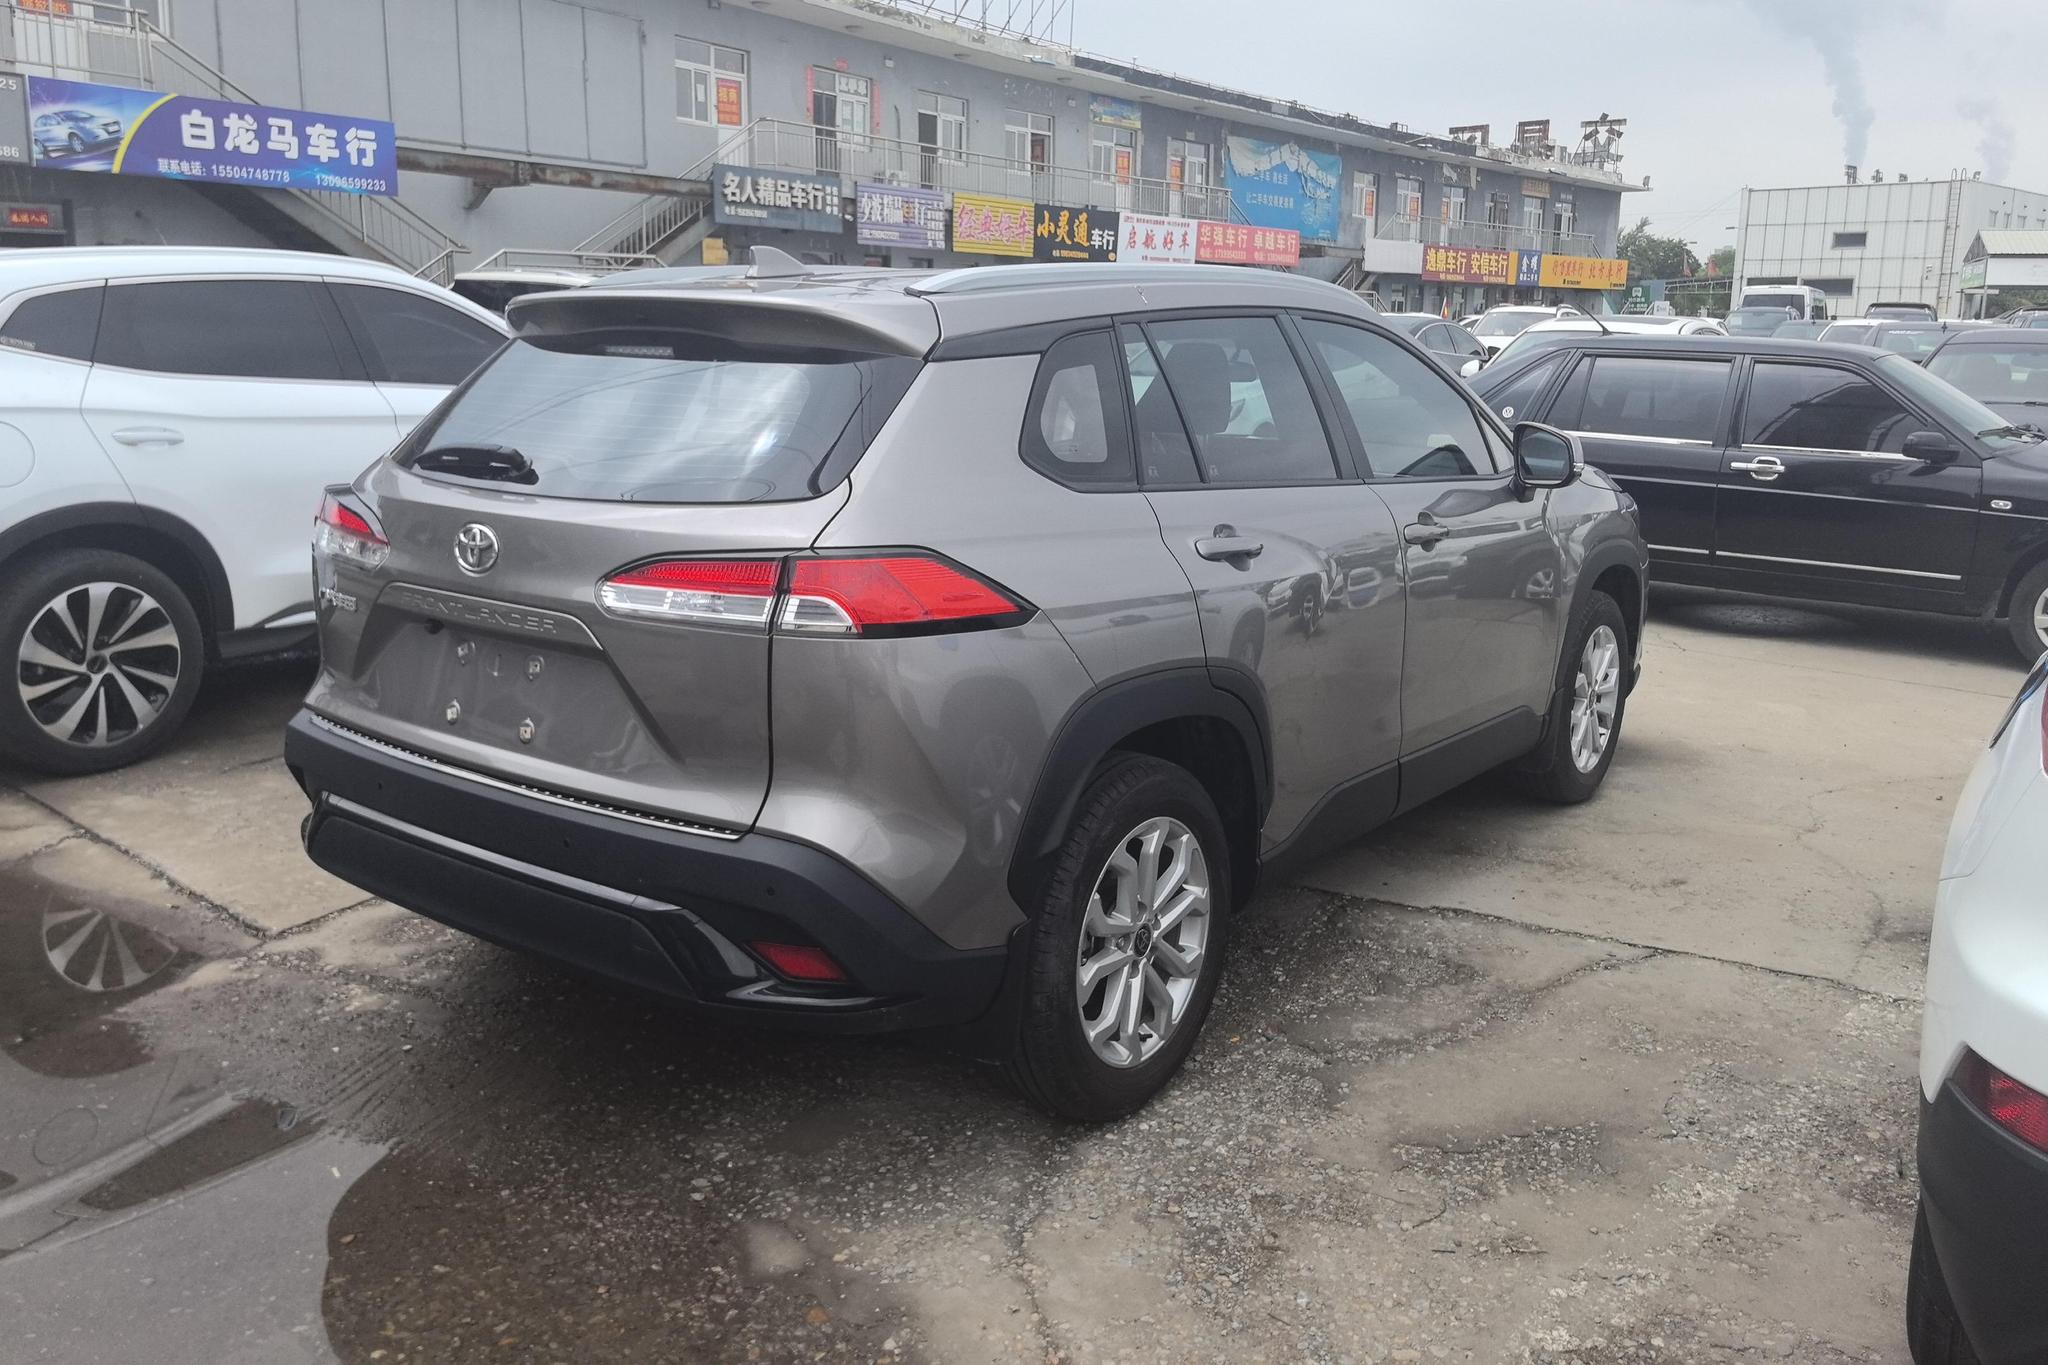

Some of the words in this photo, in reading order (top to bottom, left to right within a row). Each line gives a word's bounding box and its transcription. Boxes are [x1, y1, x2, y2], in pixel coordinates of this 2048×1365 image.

[181, 109, 377, 167] 白龙马车行
[722, 172, 825, 211] 名人精品车行
[1200, 224, 1248, 249] 华强车行
[1470, 252, 1508, 276] 安信车行
